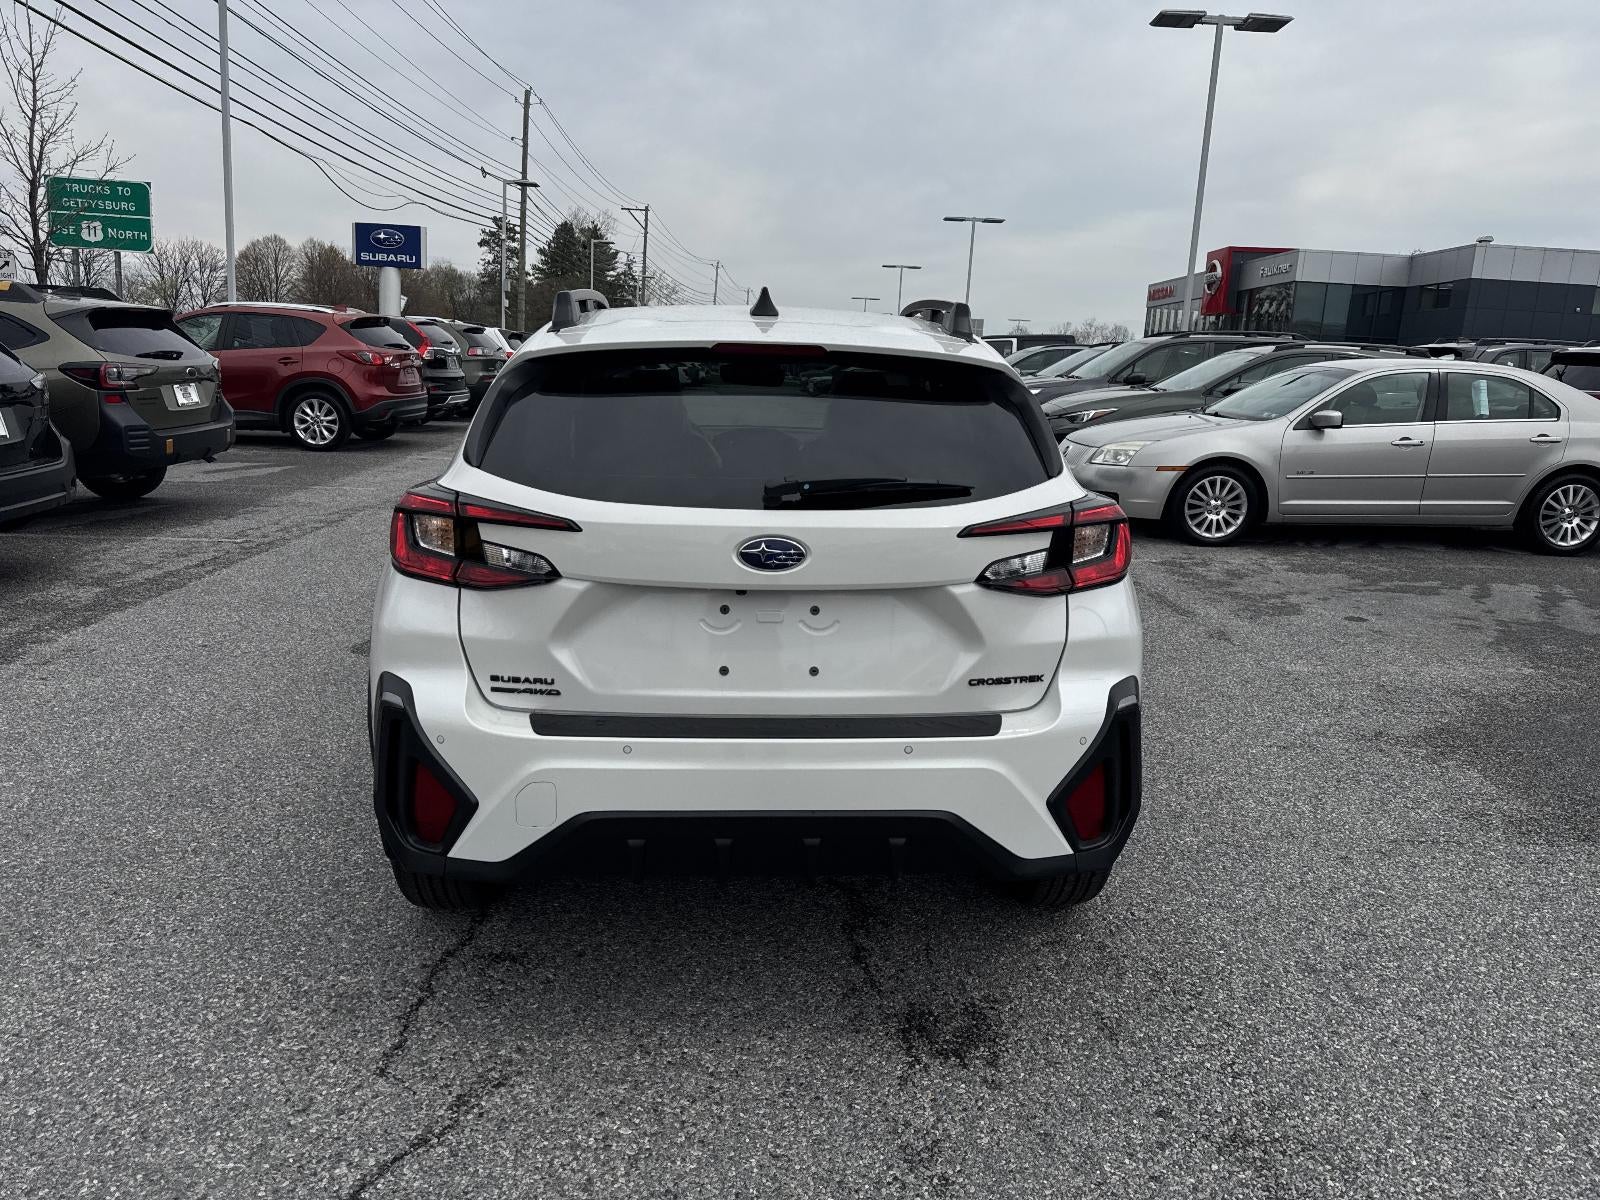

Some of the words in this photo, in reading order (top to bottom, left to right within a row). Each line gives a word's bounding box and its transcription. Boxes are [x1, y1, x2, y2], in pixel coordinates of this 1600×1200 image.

[65, 183, 110, 195] TRUCKS
[117, 186, 131, 196] TO
[62, 198, 136, 211] GETTYSBURG
[87, 225, 98, 238] 11
[107, 228, 148, 241] NORTH
[0, 251, 12, 259] EEP
[360, 252, 416, 263] SUBARU
[1260, 263, 1291, 277] Faulkner
[490, 674, 555, 686] SUBARU
[968, 674, 1044, 687] CROSSTREK
